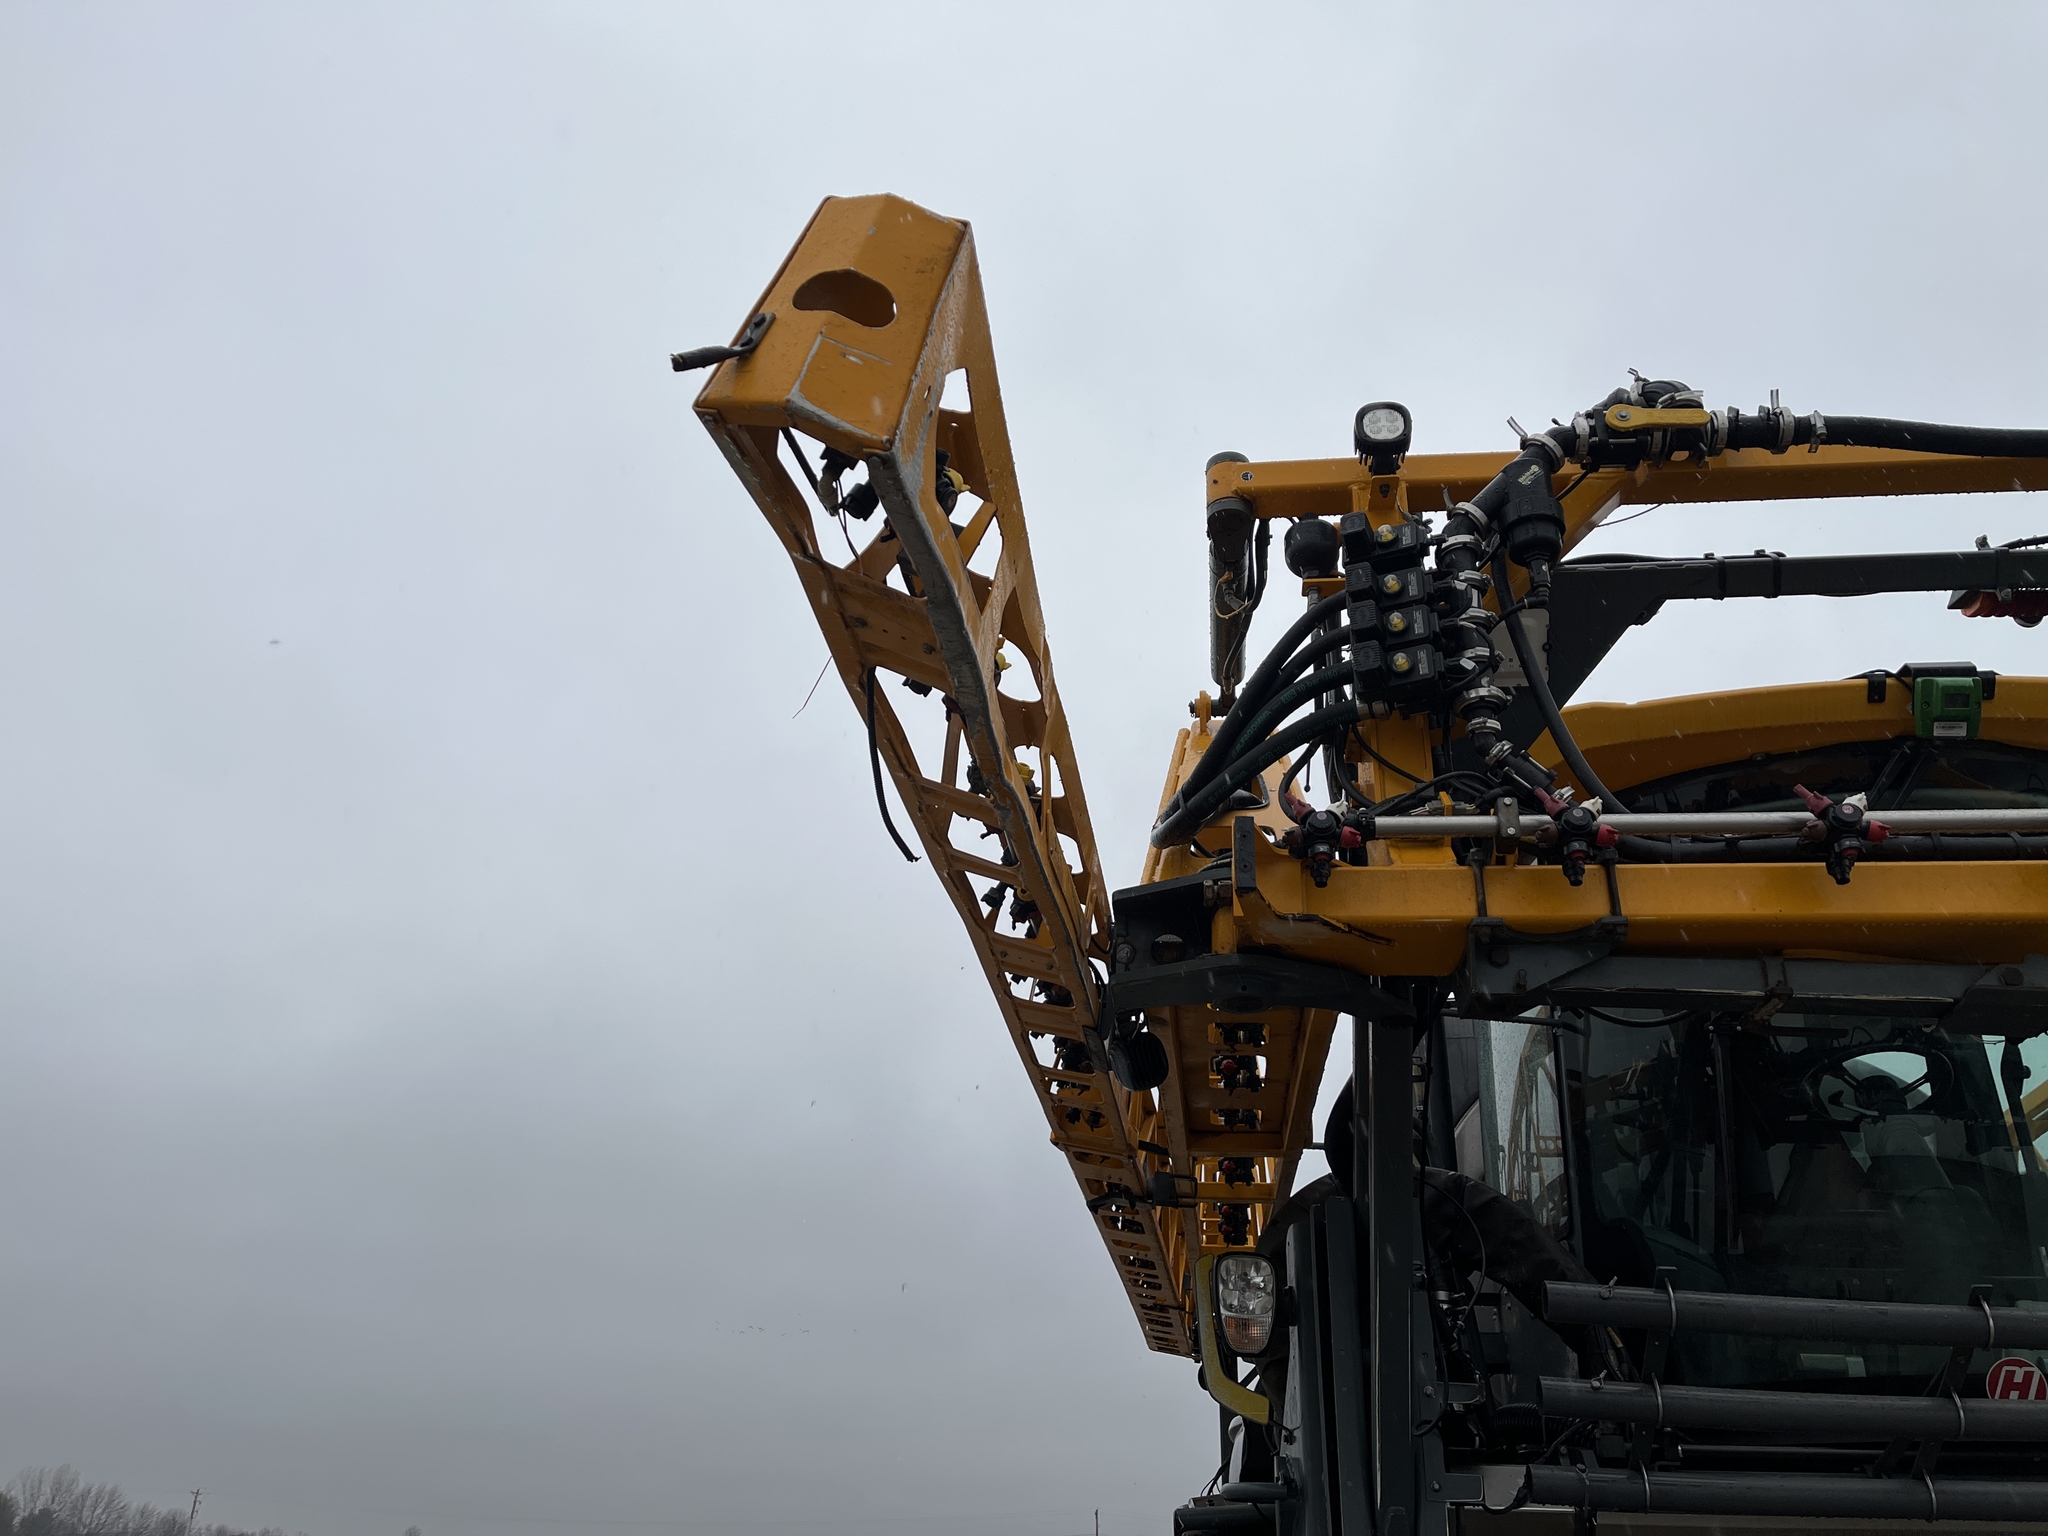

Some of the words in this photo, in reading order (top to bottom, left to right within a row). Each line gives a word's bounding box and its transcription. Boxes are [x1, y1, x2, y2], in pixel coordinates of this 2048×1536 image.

[1236, 710, 1272, 753] ALFAGOMMA
[1282, 690, 1297, 703] 202
[1296, 684, 1306, 692] 10
[1306, 677, 1320, 687] bar
[1321, 669, 1338, 680] (150
[1259, 752, 1275, 765] 202
[1995, 1366, 2040, 1400] H
